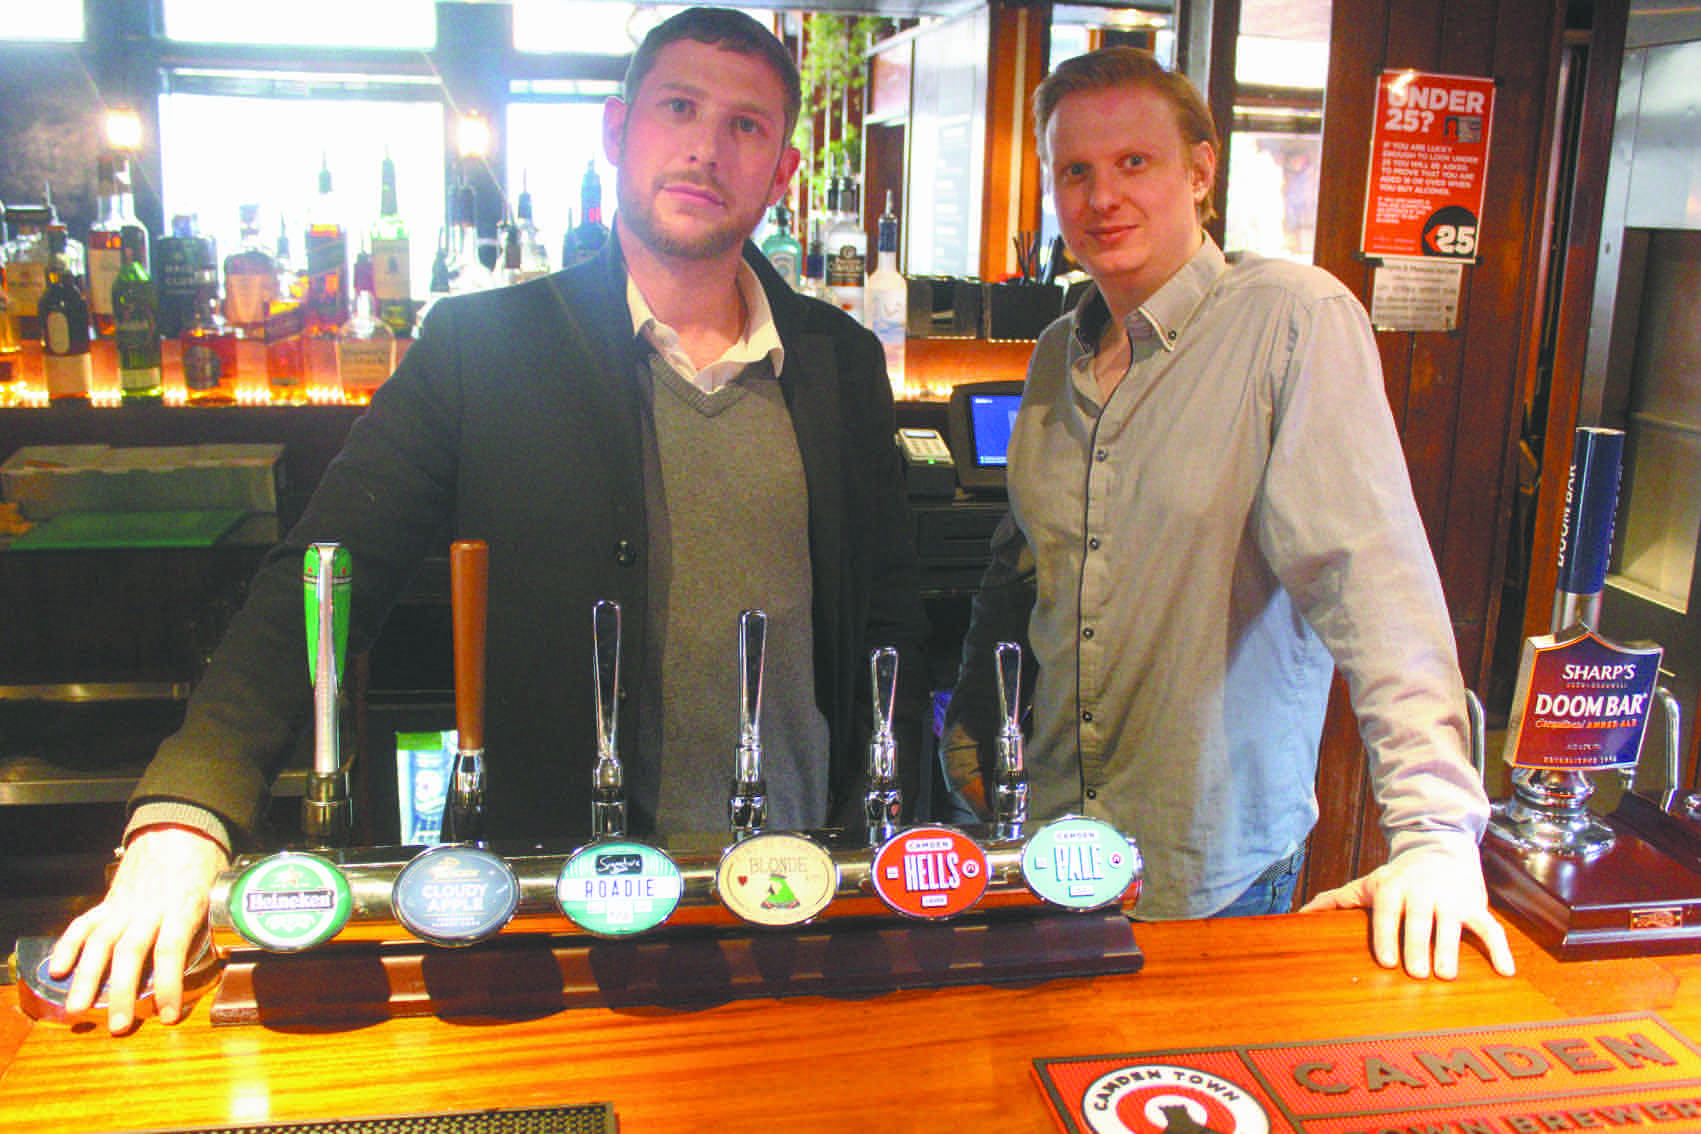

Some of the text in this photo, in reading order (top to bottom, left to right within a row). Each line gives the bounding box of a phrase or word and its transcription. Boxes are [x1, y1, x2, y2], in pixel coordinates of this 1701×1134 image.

[1388, 85, 1484, 113] UNDER
[1384, 108, 1435, 133] 25?
[1436, 225, 1475, 255] 25
[1563, 664, 1637, 680] SHARP'S
[1535, 693, 1644, 717] DOOM BAR
[750, 856, 808, 873] BLONDE
[904, 851, 960, 891] HELLS
[1054, 843, 1104, 882] PALE
[422, 883, 488, 898] CLOUDY
[585, 879, 655, 898] ROADIE
[248, 892, 329, 910] Heineken
[427, 897, 484, 912] APPLE
[1293, 1033, 1678, 1095] CAMDEN
[1094, 1069, 1240, 1112] CAMDEN TOWN
